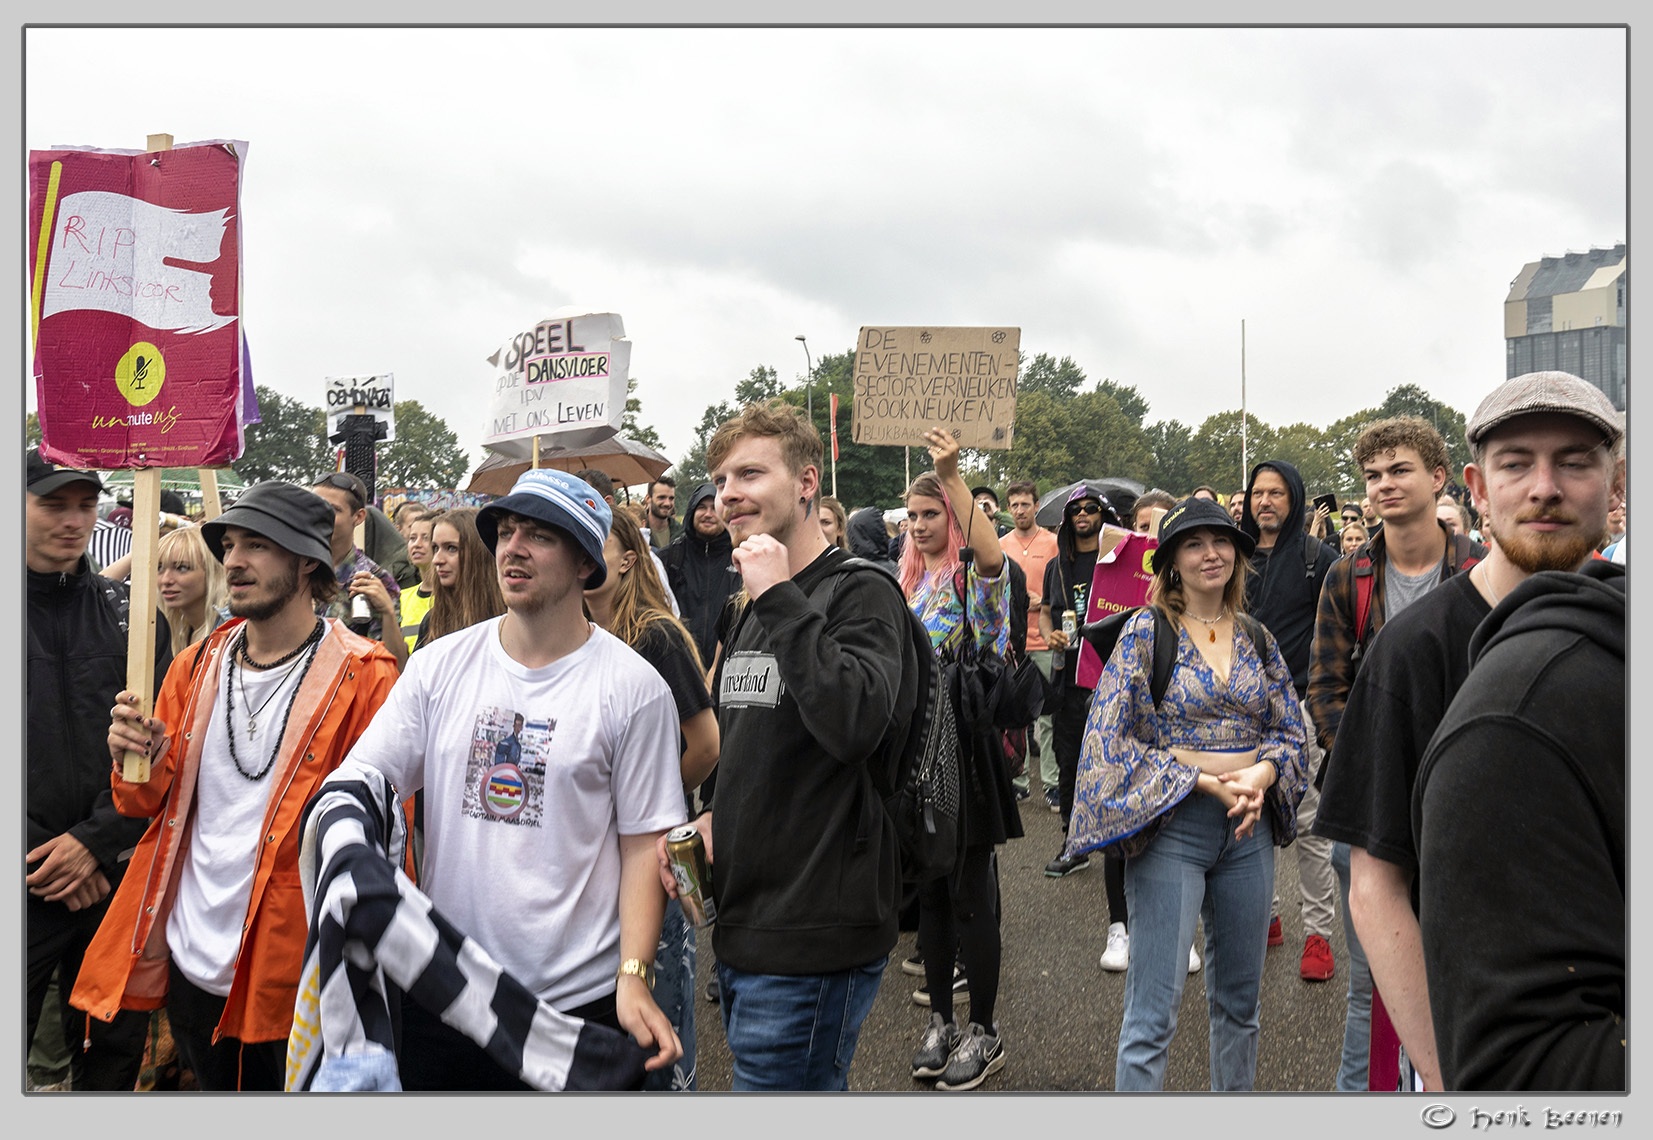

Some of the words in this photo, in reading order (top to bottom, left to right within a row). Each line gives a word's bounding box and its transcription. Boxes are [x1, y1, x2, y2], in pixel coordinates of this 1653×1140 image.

[63, 215, 136, 259] RIP
[504, 319, 585, 373] SPEEL
[865, 328, 897, 350] DE
[527, 356, 609, 383] DANSVLOER
[856, 374, 917, 397] SECTOR
[919, 376, 1017, 399] VERNEUKEN
[526, 408, 550, 428] ONS
[857, 397, 875, 420] IS
[877, 399, 910, 420] OOK
[913, 398, 995, 423] NEUKEN
[525, 471, 569, 490] ellesse
[1097, 597, 1133, 613] Enou
